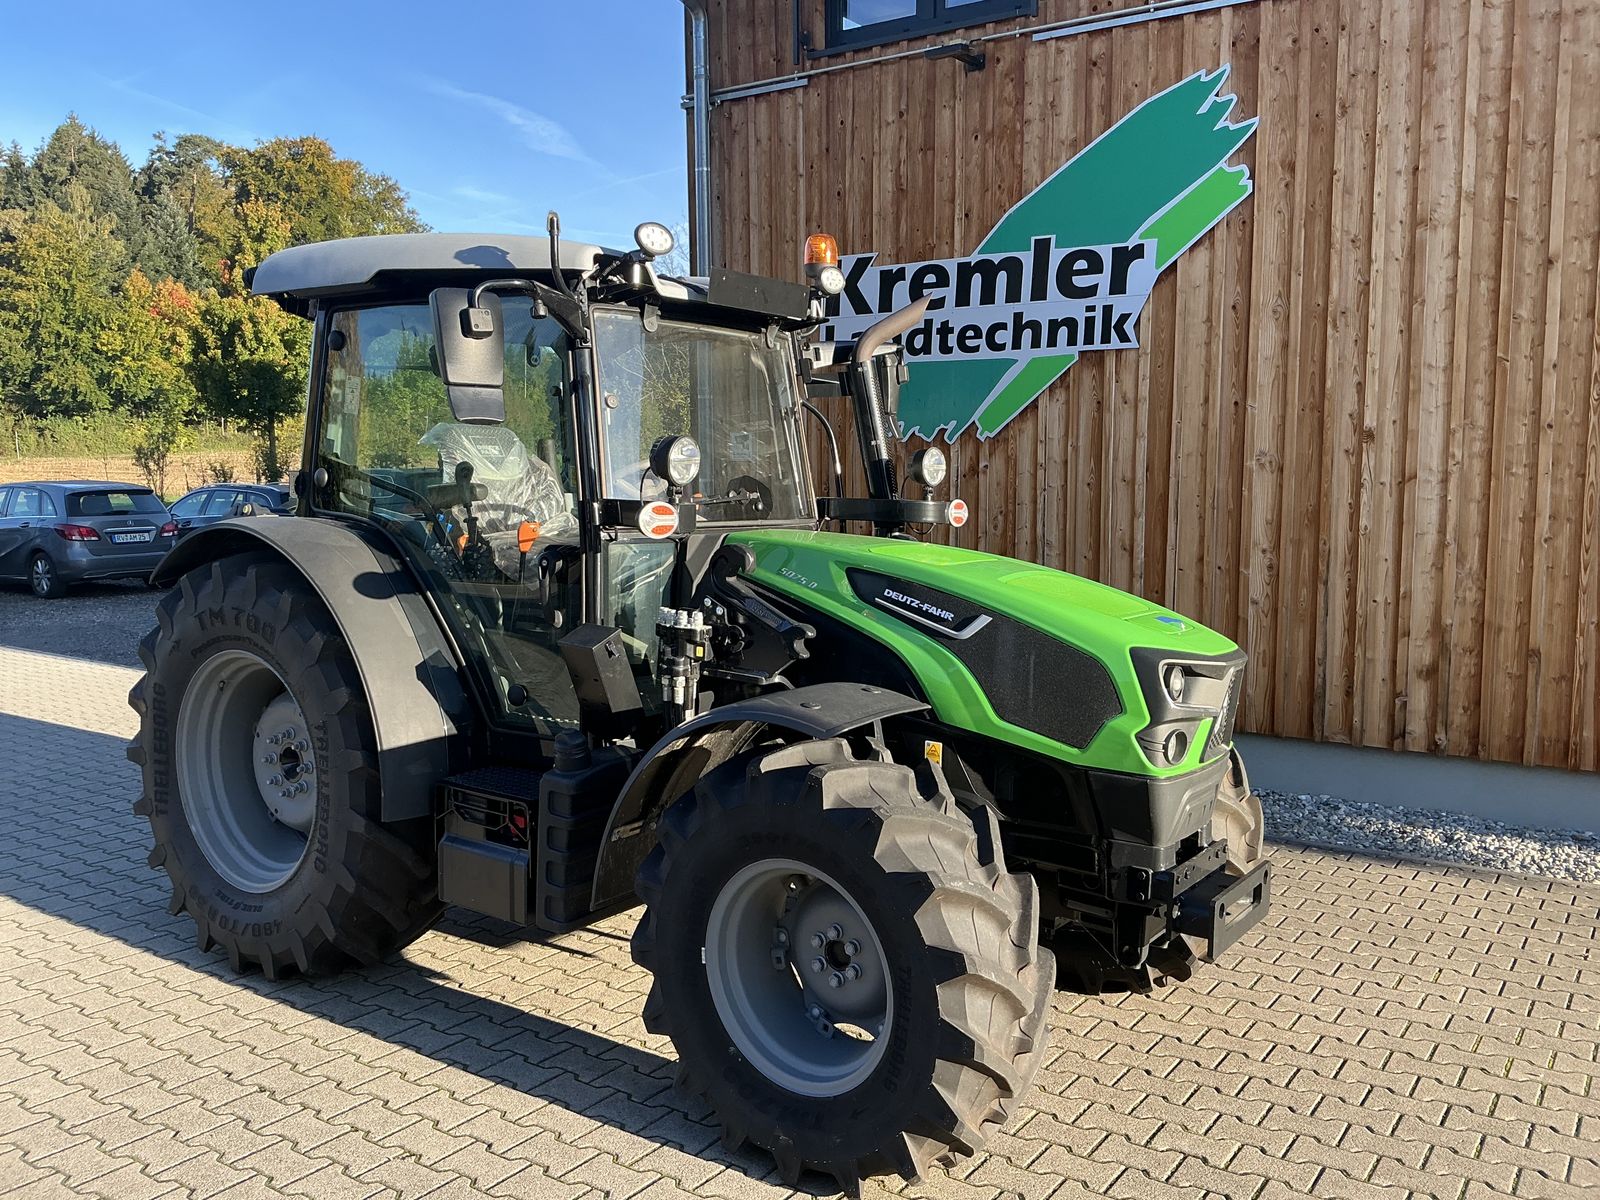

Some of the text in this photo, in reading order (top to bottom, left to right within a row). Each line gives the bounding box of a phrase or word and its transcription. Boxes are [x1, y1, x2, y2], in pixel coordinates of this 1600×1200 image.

[826, 237, 1145, 317] Kremler
[825, 304, 1134, 357] dtechnik
[192, 606, 226, 632] TM
[883, 588, 955, 622] DEUTZ-FAHR
[153, 682, 169, 818] TRELLEBORG
[313, 719, 330, 874] TRELLEBORG
